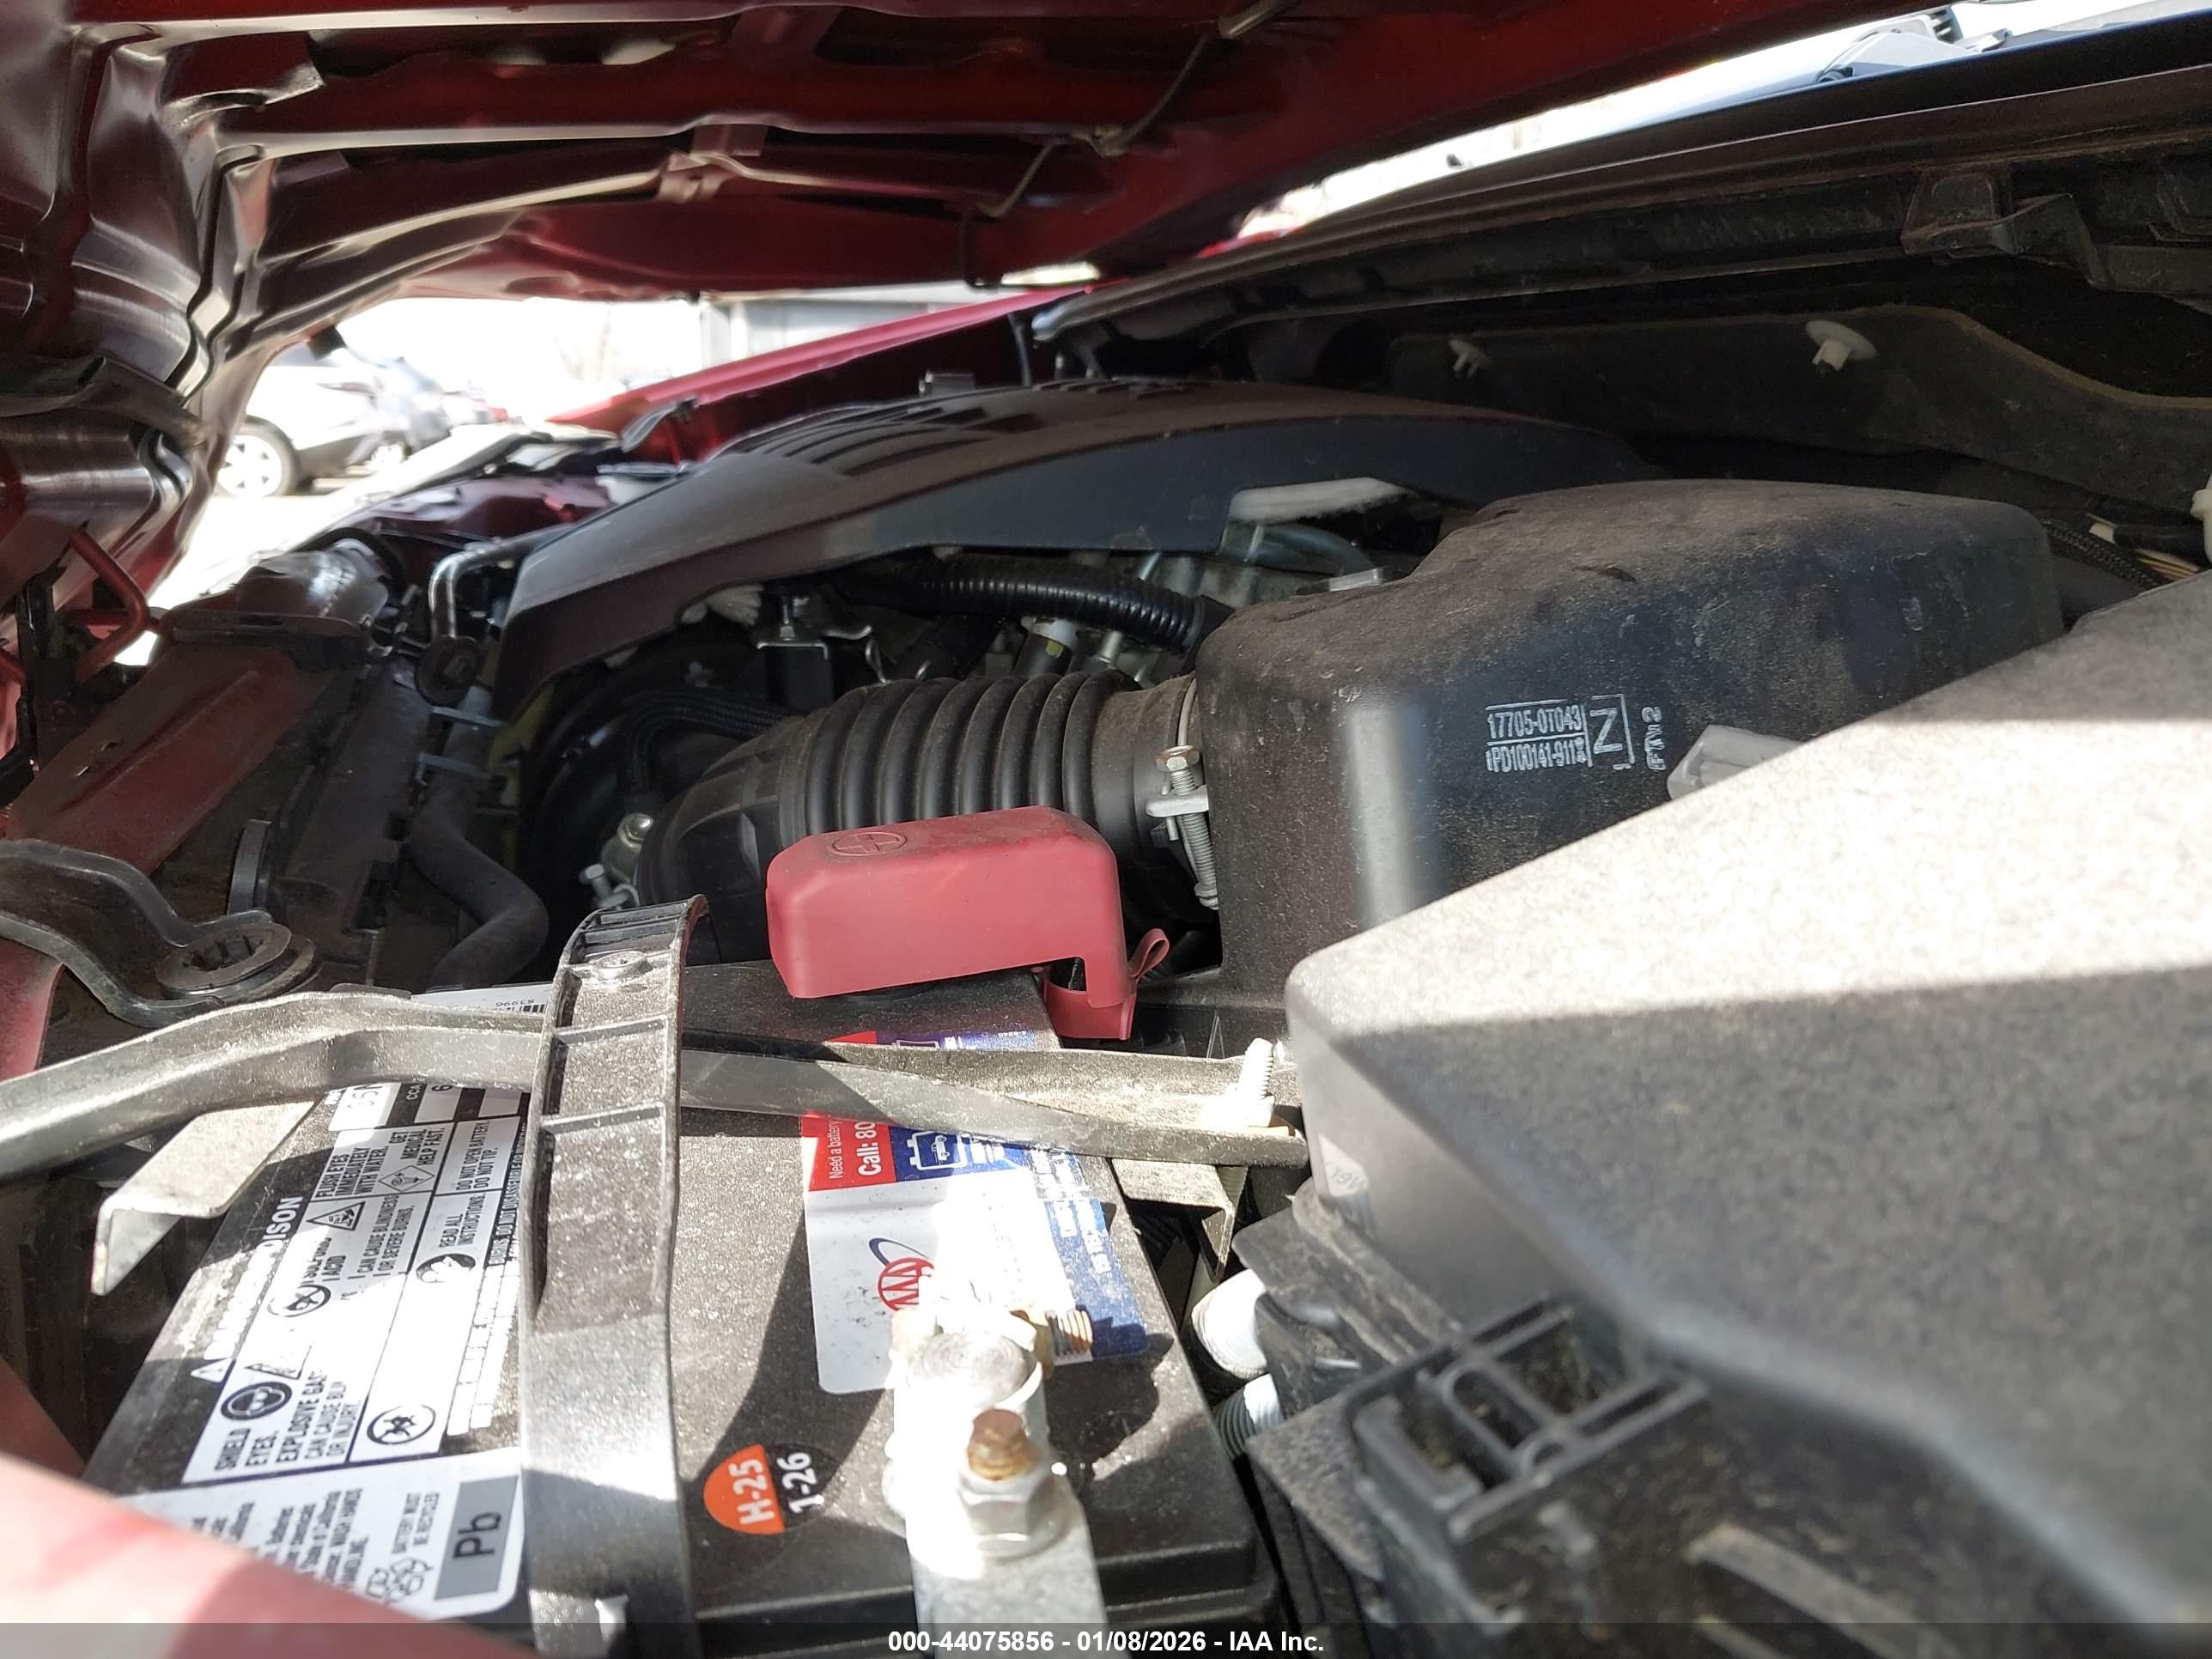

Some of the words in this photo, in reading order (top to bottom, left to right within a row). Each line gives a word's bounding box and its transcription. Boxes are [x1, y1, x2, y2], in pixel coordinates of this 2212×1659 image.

[388, 1131, 410, 1145] GET
[400, 1128, 428, 1160] MEDICAL
[416, 1147, 438, 1166] HELP
[463, 1147, 483, 1165] OPEN
[830, 1147, 842, 1156] a
[856, 1141, 883, 1176] Call:
[325, 1153, 350, 1173] EYES
[334, 1147, 371, 1196] IMMEDIATELY
[459, 1165, 478, 1180] NOT
[476, 1160, 495, 1176] NOT
[828, 1155, 844, 1180] Need
[314, 1174, 342, 1198] FLUSH
[353, 1174, 379, 1195] WITH
[455, 1179, 473, 1191] DO
[473, 1176, 491, 1189] DO
[445, 1212, 464, 1227] ALL
[439, 1227, 459, 1248] READ
[356, 1257, 377, 1273] CAN
[276, 1398, 319, 1463] EXPLOSIVE
[214, 1427, 251, 1471] SHIELD
[728, 1458, 775, 1525] H-25
[775, 1452, 825, 1514] 1-26
[453, 1511, 502, 1559] Pb
